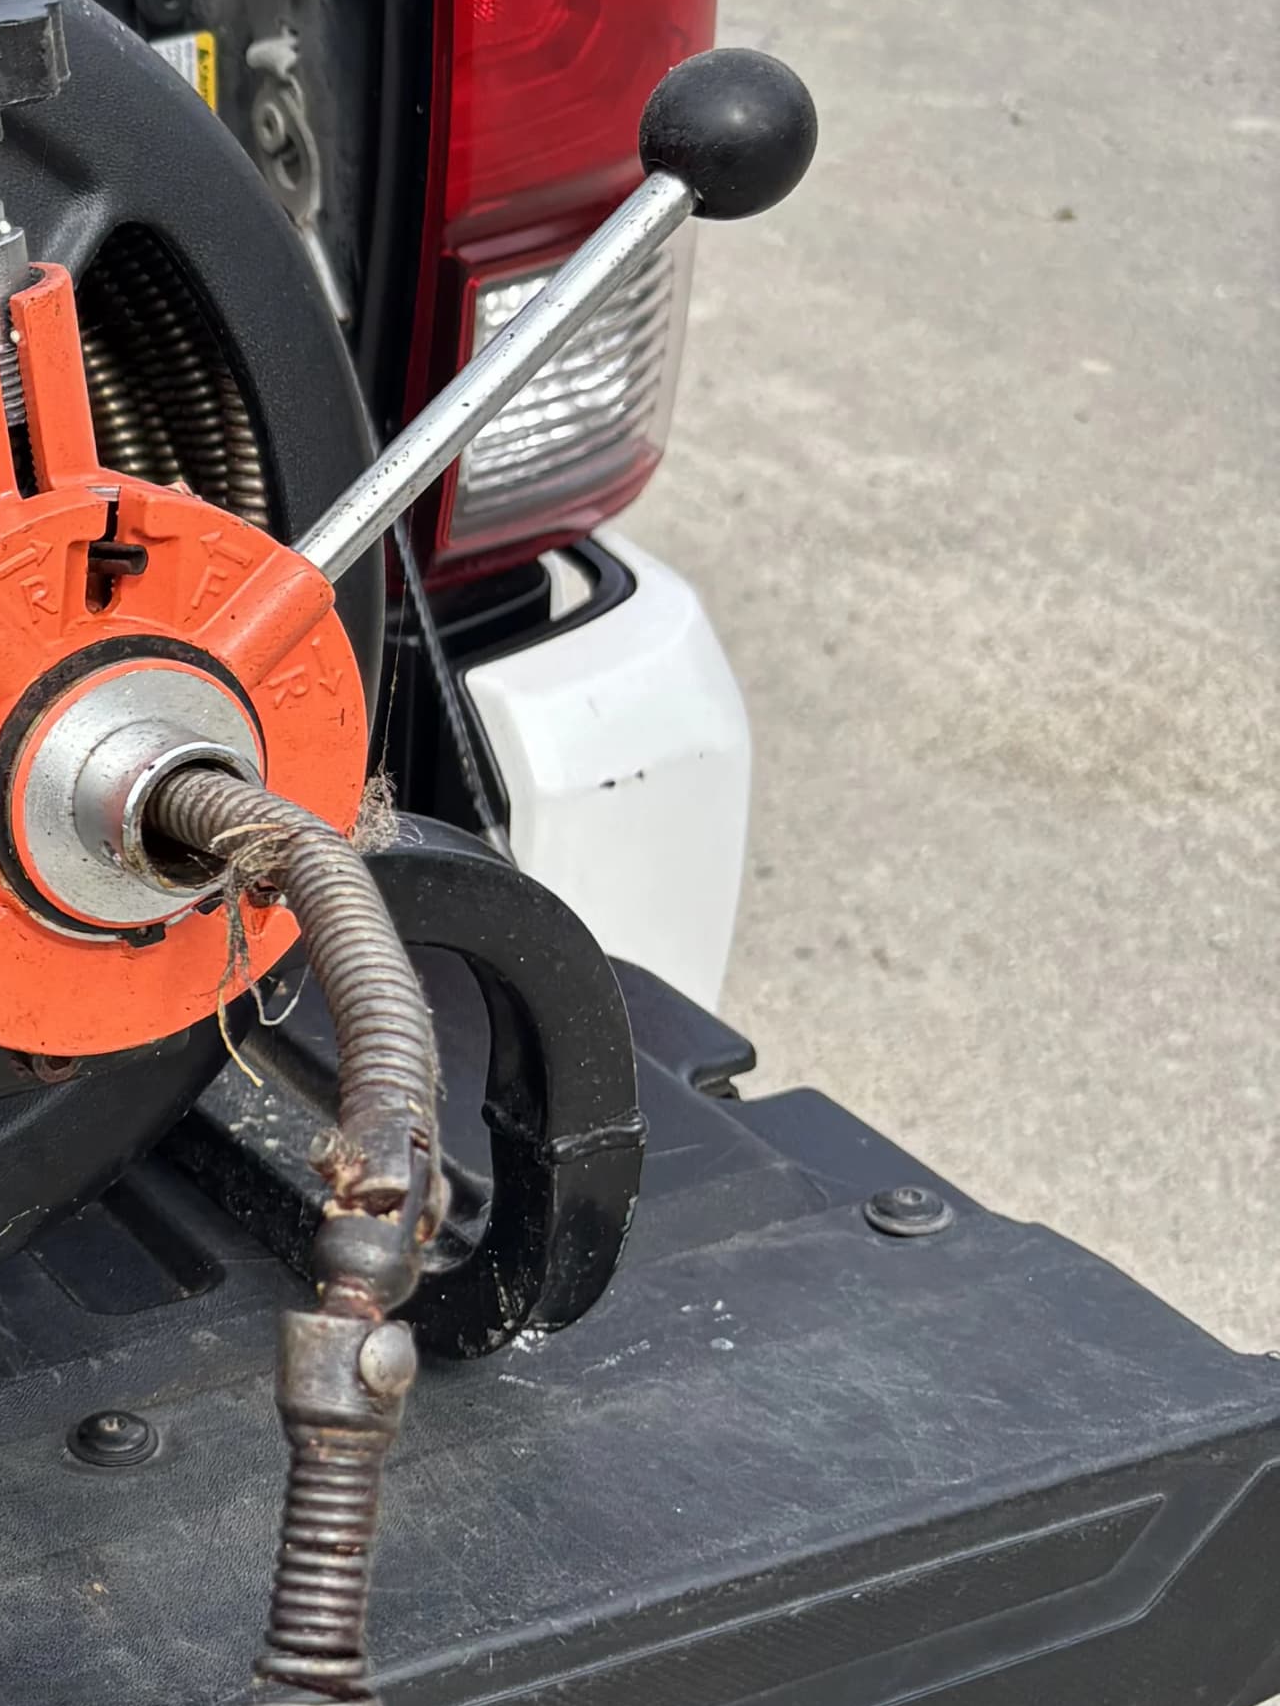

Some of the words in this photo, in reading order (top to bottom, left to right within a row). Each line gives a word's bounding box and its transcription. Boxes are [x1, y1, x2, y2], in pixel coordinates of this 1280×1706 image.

[18, 574, 59, 624] R
[189, 565, 227, 609] F
[267, 664, 312, 709] R
